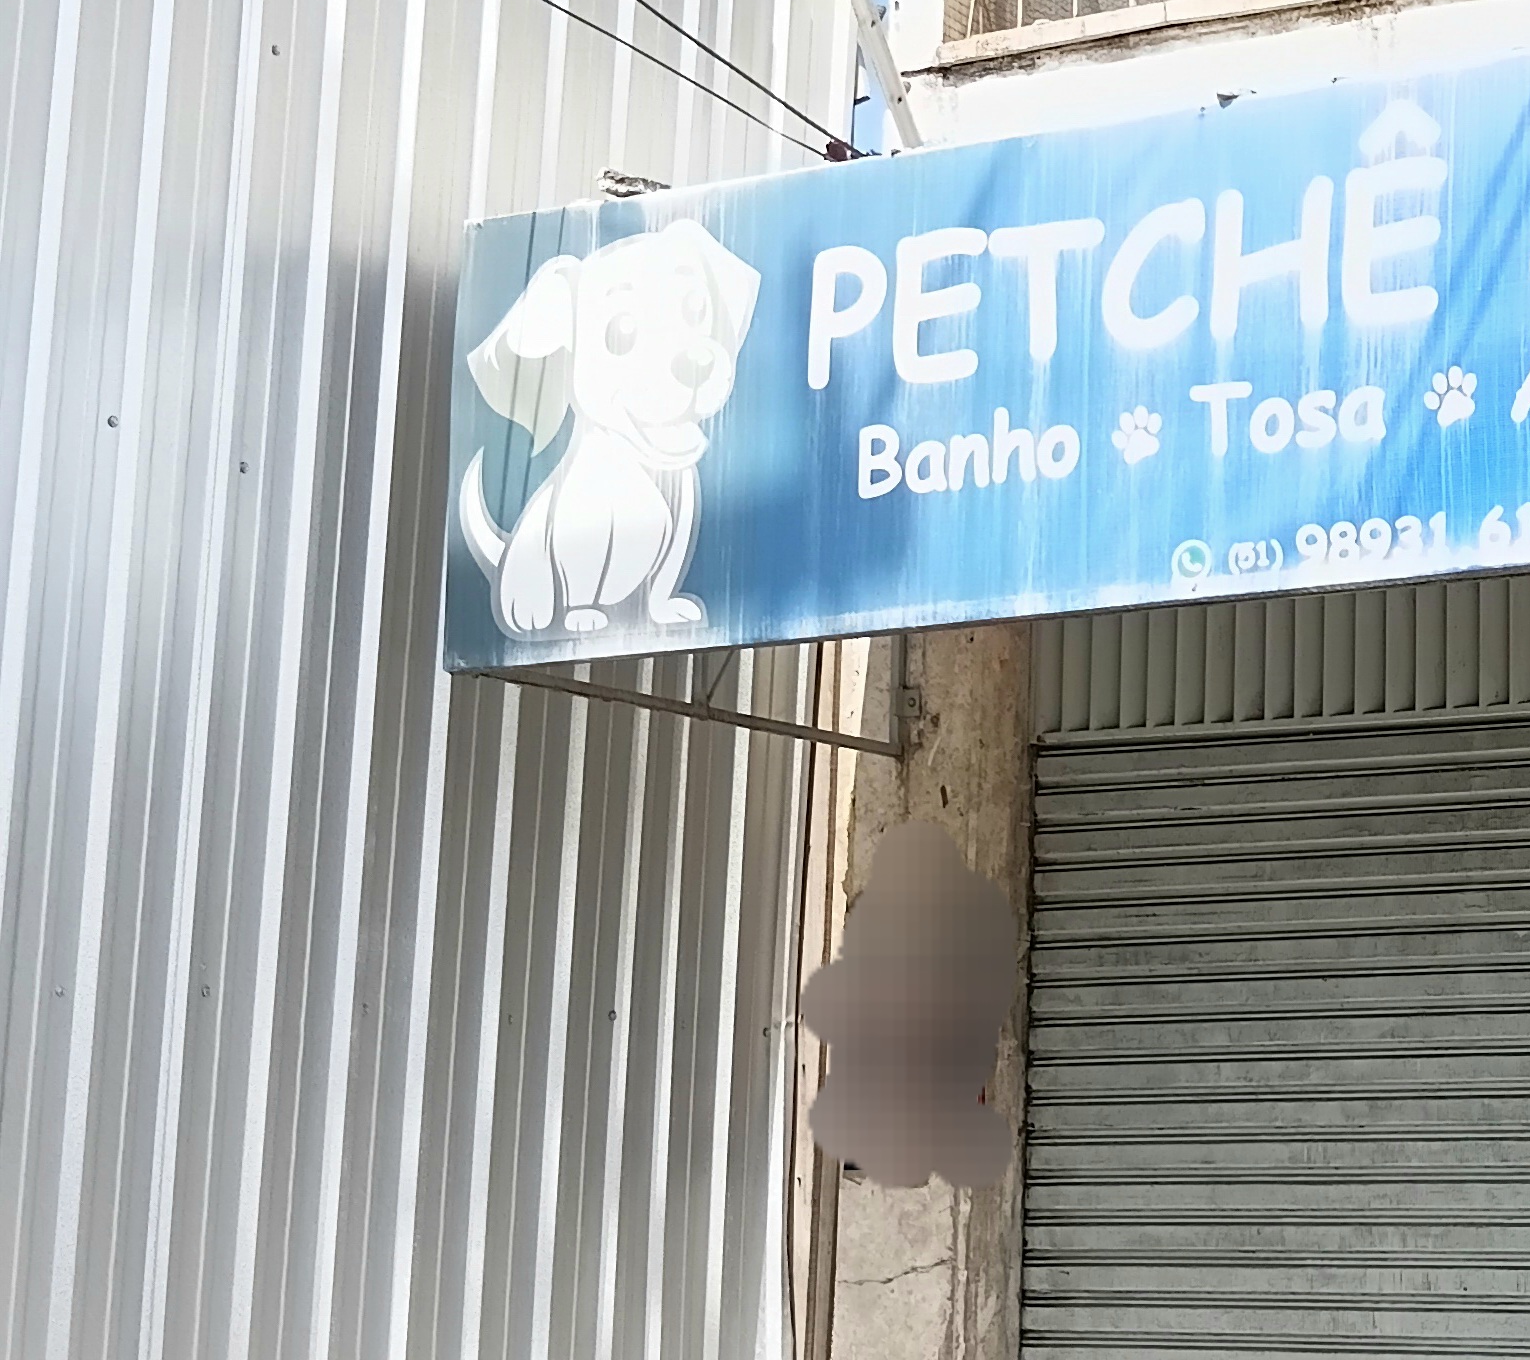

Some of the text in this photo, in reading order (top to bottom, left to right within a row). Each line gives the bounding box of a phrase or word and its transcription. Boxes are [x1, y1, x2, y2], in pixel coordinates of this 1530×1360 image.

[807, 97, 1449, 391] PETCHÊ
[857, 407, 1081, 501] Banho
[1189, 380, 1387, 457] Tosa
[1228, 538, 1284, 576] (51)
